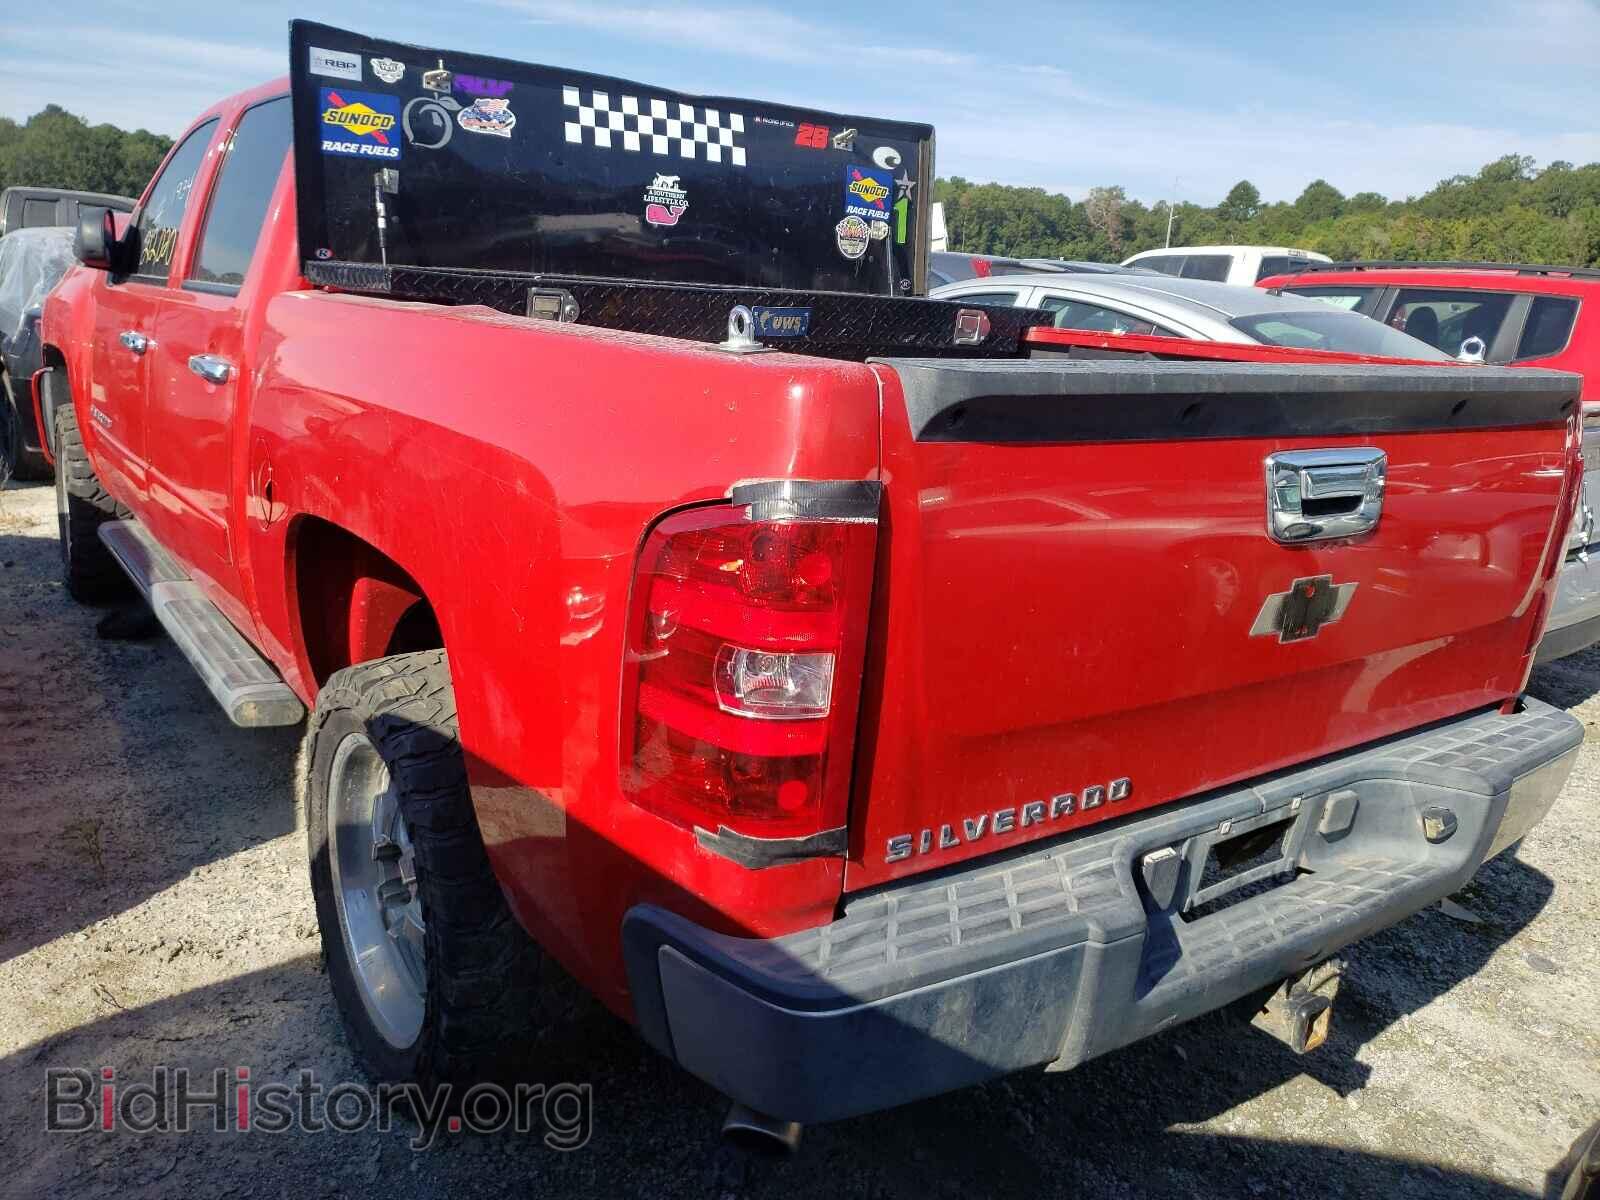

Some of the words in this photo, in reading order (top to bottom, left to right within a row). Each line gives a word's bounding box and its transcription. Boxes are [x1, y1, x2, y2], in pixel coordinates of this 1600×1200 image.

[325, 59, 357, 69] RBP
[326, 110, 393, 129] SUNOCO
[795, 122, 830, 149] 28
[322, 140, 359, 154] RACE
[360, 142, 400, 158] FUELS
[851, 181, 889, 199] SUNOCO
[846, 205, 868, 216] RACE
[868, 209, 890, 220] FUELS
[884, 777, 1133, 863] SILVERADO
